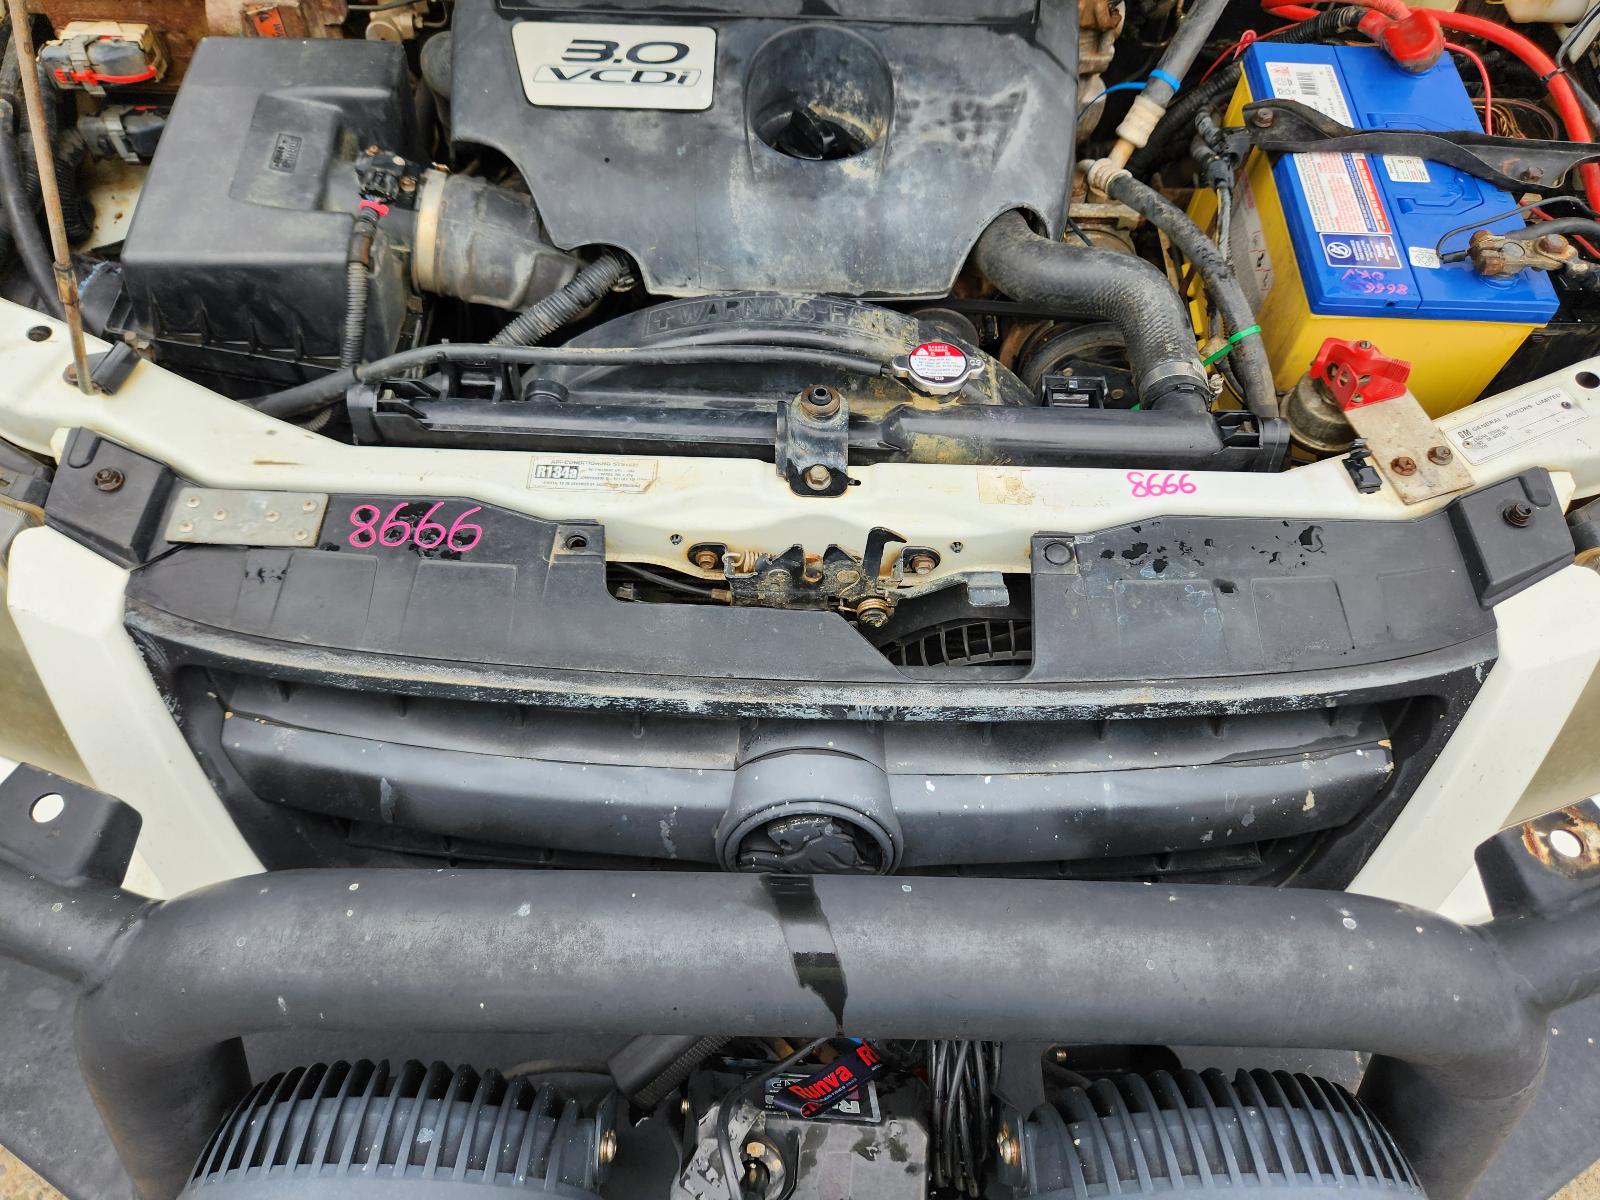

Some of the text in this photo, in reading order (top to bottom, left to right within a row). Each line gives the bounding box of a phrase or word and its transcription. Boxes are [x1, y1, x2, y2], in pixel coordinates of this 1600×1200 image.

[561, 39, 690, 64] 3.0
[550, 67, 690, 84] VCDi
[1364, 283, 1409, 296] 8666
[1472, 417, 1502, 432] GENERAL
[1505, 404, 1533, 418] MOTORS
[1536, 392, 1561, 406] LIMITED
[535, 465, 579, 479] R134a
[1127, 471, 1197, 498] 8666
[348, 502, 483, 552] 8666
[788, 1065, 854, 1100] Runva
